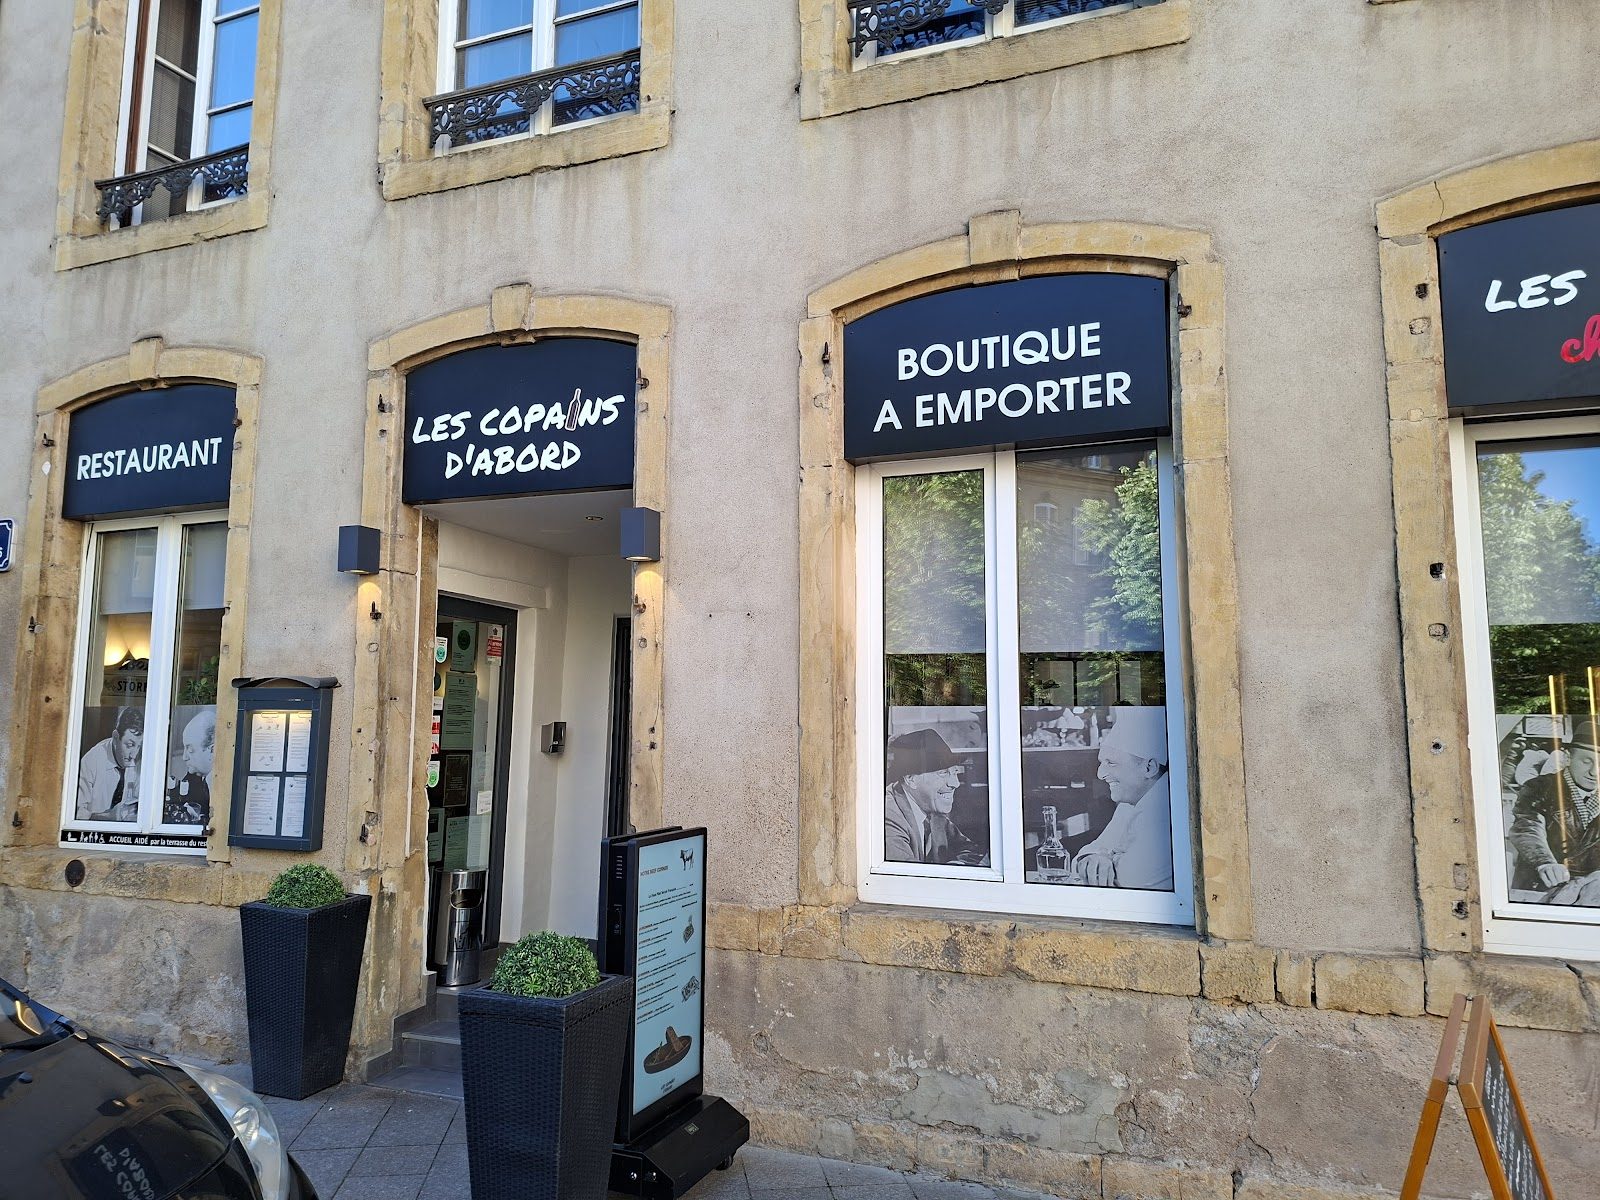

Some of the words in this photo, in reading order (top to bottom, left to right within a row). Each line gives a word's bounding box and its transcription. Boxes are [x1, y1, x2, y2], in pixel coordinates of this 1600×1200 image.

[1485, 269, 1587, 313] LES
[898, 321, 1101, 380] BOUTIQUE
[873, 399, 902, 432] A
[915, 371, 1131, 428] EMPORTER
[412, 411, 472, 444] LES
[76, 437, 223, 480] RESTAURANT
[444, 440, 581, 479] D'ABORD
[109, 835, 132, 844] ACCUEIL
[134, 836, 149, 845] AIDÉ
[160, 838, 166, 846] la
[166, 839, 188, 847] terrasse
[188, 839, 197, 847] du
